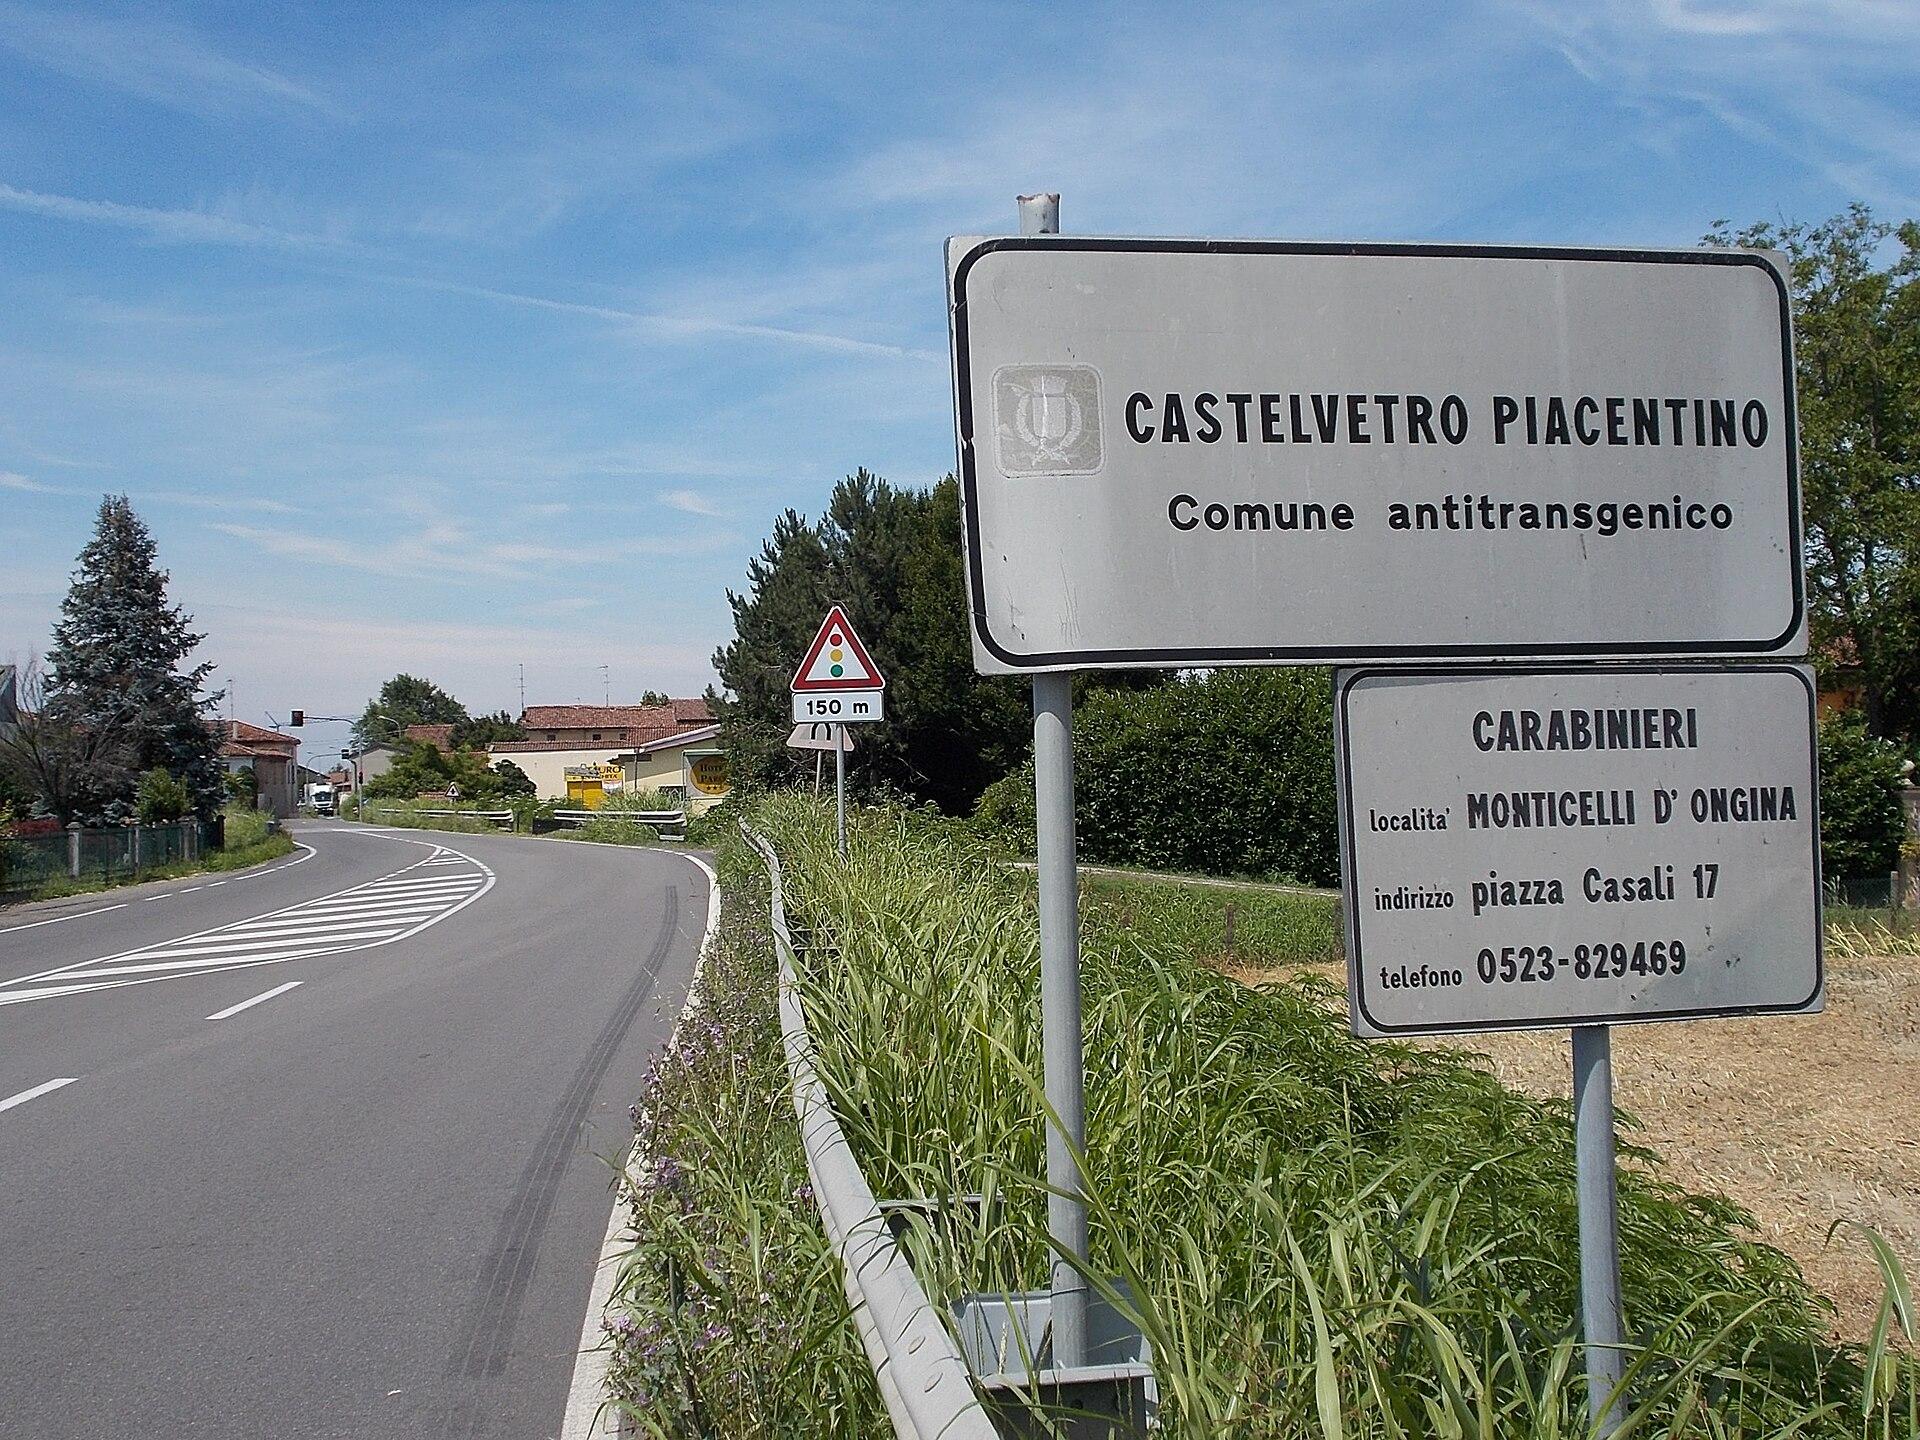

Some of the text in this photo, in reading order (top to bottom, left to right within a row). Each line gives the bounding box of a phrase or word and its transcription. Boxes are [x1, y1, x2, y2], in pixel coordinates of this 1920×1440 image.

[1125, 392, 1769, 449] CASTELVETRO PIACENTINO
[1168, 494, 1733, 537] Comune antitransgenico
[806, 699, 869, 716] 150 m
[1472, 708, 1698, 752] CARABINIERI
[1369, 786, 1797, 832] localita' MONTICELLI D' ONGINA
[1374, 864, 1719, 916] indirizzo piazza Casali 17
[1379, 940, 1686, 990] telefono 0523-829469
